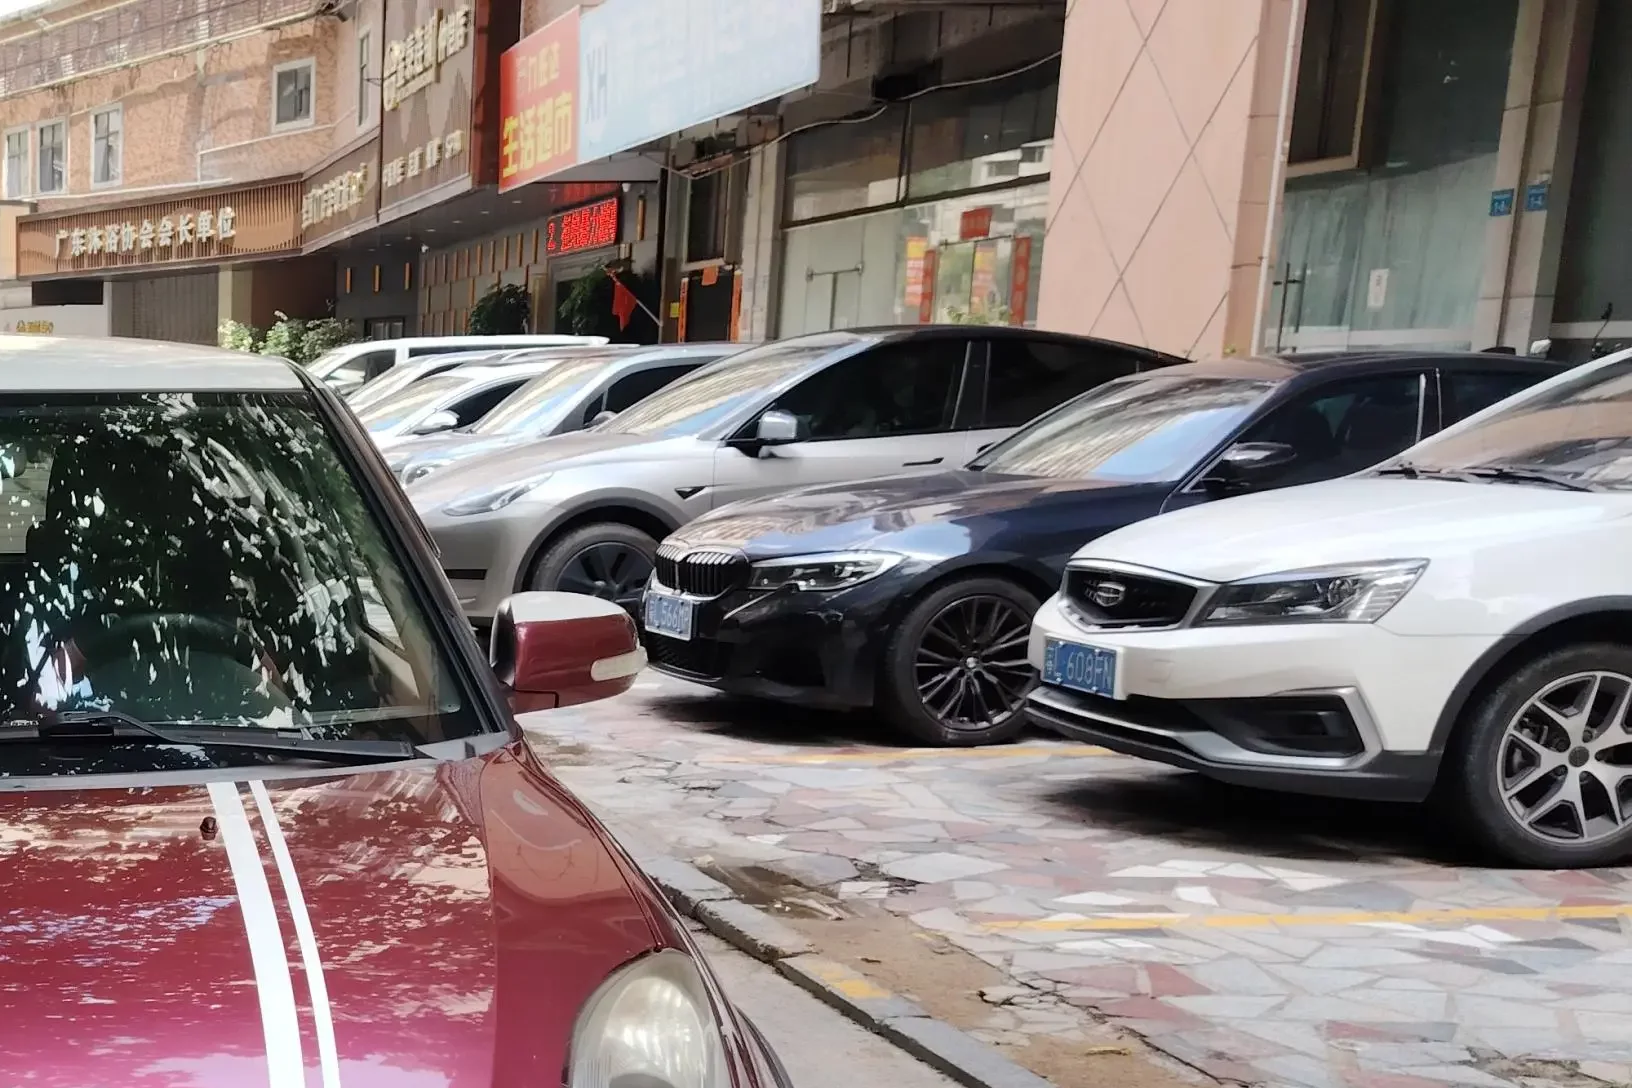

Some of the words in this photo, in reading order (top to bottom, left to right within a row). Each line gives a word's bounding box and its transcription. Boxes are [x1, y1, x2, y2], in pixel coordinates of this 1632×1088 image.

[502, 91, 573, 178] 生活超市
[54, 206, 236, 259] 广东沐浴协会会长单位
